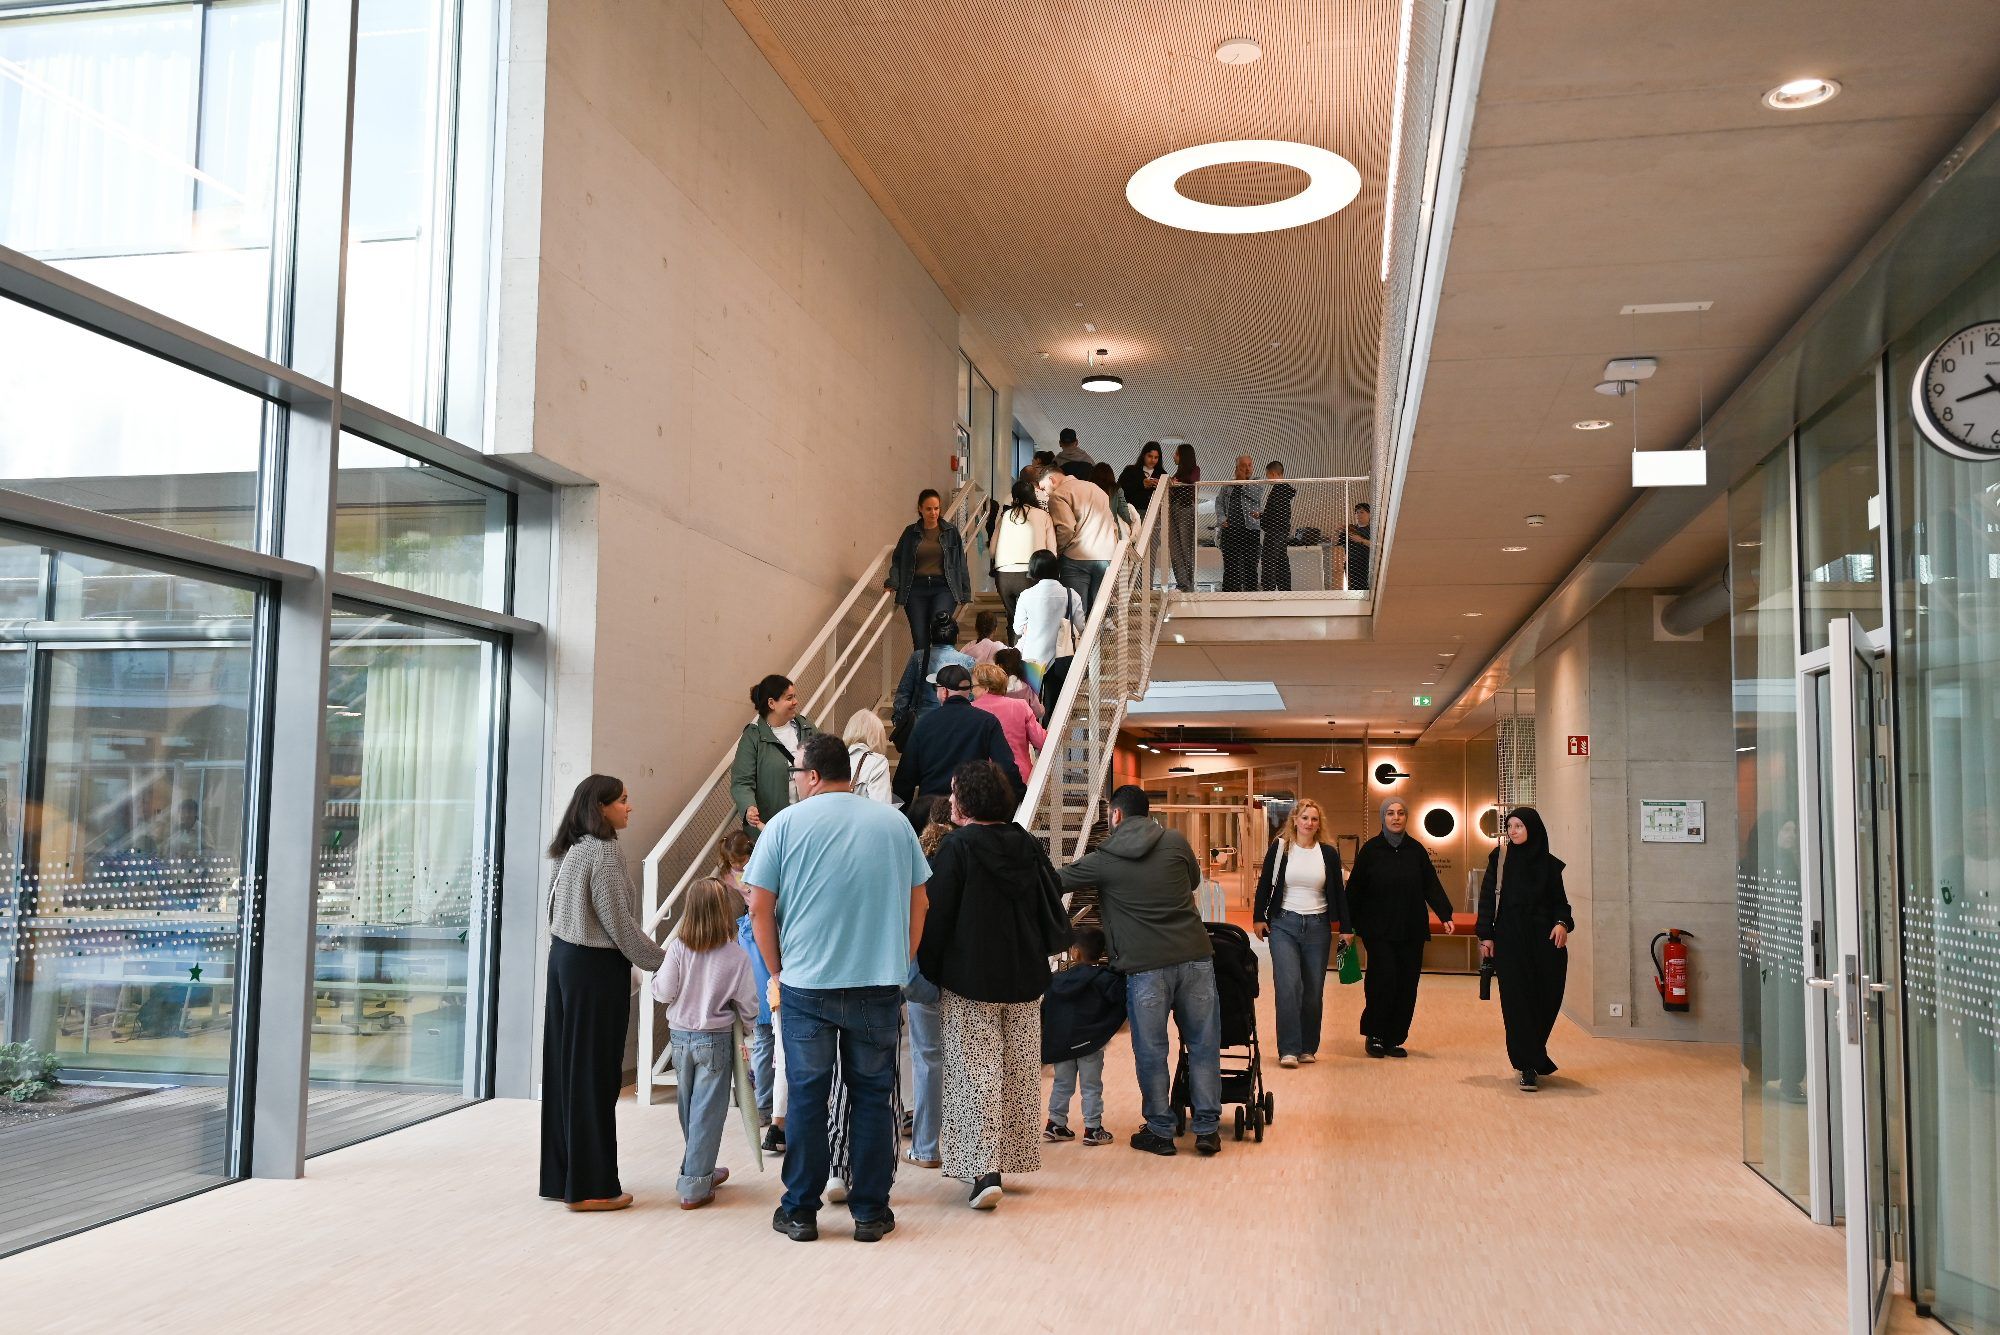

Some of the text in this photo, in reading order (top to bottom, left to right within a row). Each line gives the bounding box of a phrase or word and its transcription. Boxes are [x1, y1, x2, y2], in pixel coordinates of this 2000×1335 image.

[1985, 332, 2000, 346] 12
[1962, 340, 1973, 355] 11
[1941, 358, 1956, 373] 10
[1933, 383, 1945, 397] 9
[1942, 406, 1953, 421] 8
[1963, 423, 1975, 437] 7
[1991, 429, 2000, 444] 6
